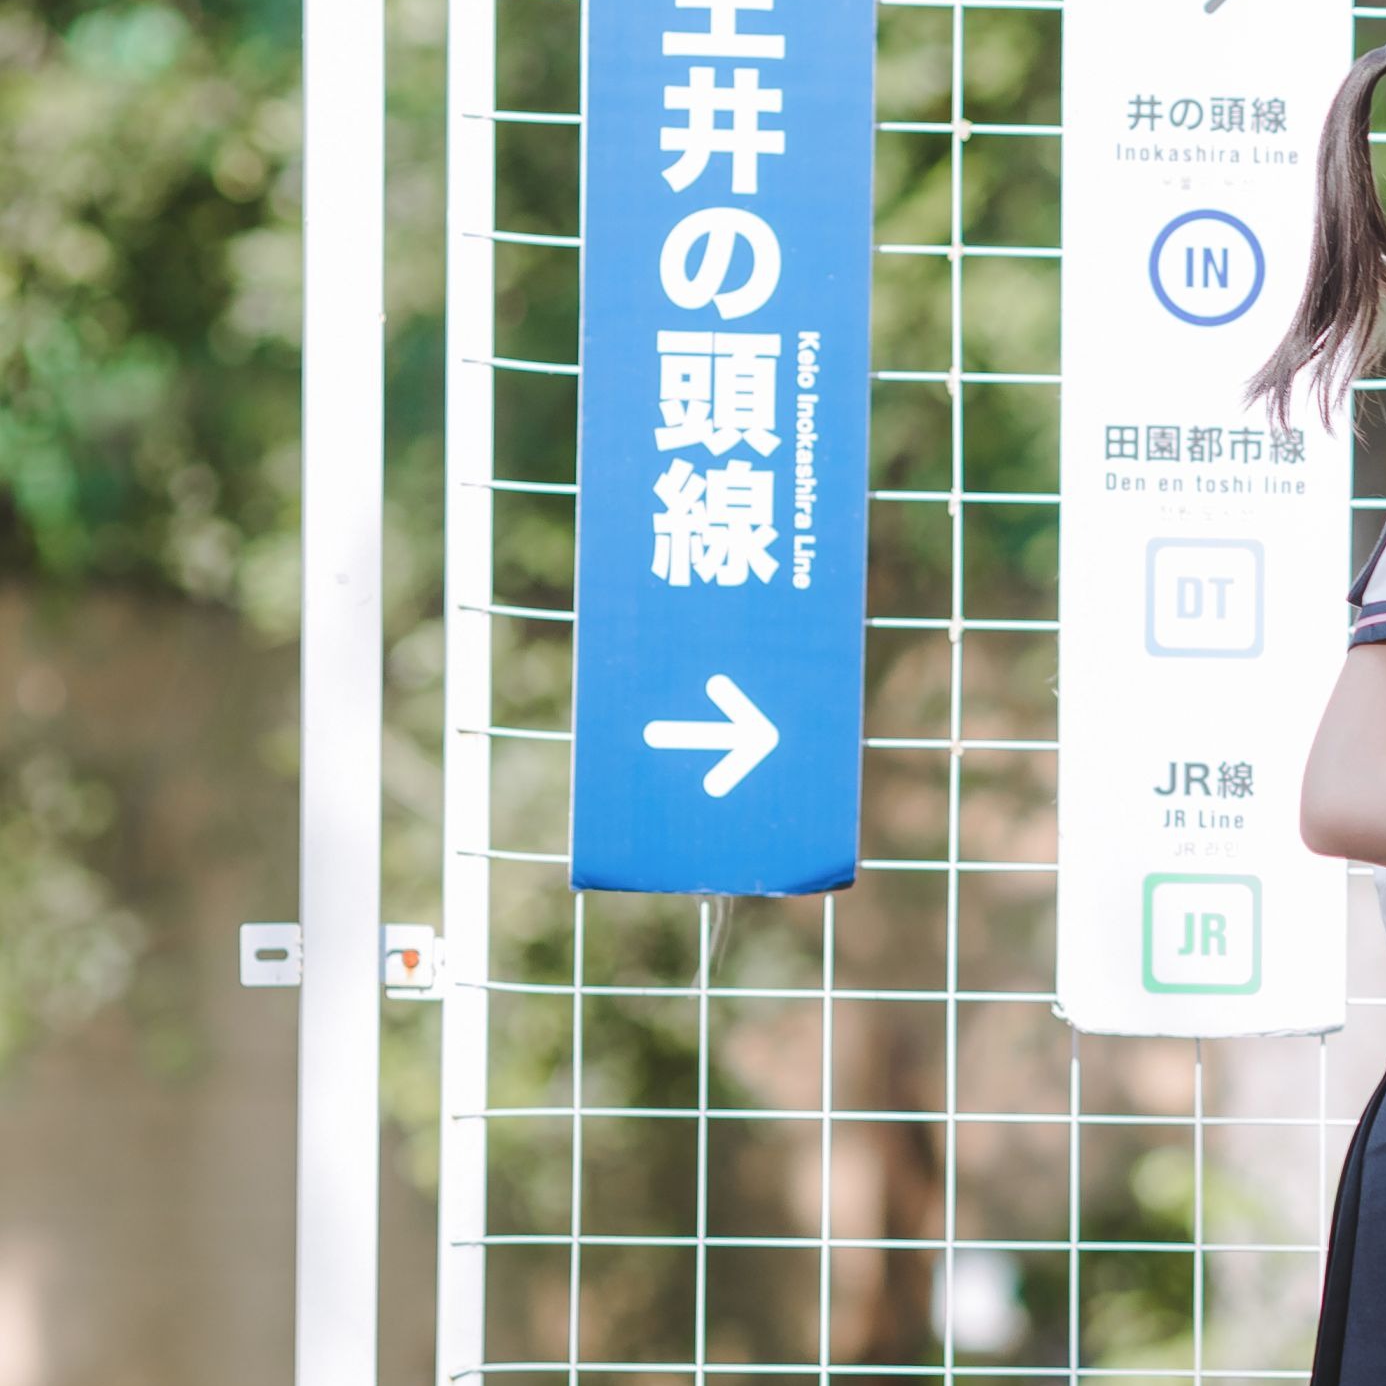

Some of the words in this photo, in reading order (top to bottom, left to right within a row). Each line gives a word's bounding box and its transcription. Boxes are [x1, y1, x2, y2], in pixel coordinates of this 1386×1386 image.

[1127, 96, 1289, 135] 井の頭線
[1116, 143, 1241, 165] Inokashira
[1252, 144, 1299, 166] Line
[1184, 247, 1230, 289] IN
[797, 330, 820, 390] Keio
[794, 393, 819, 529] Inokashira
[1104, 425, 1307, 465] 田園都市線
[1105, 472, 1147, 492] Den
[1157, 476, 1185, 493] en
[1196, 473, 1253, 495] toshi
[1263, 474, 1307, 496] line
[792, 534, 815, 590] Line
[1177, 577, 1235, 620] DT
[1154, 762, 1256, 800] JR線
[1163, 809, 1187, 829] JR
[1198, 809, 1245, 830] Line
[1178, 913, 1227, 957] JR
